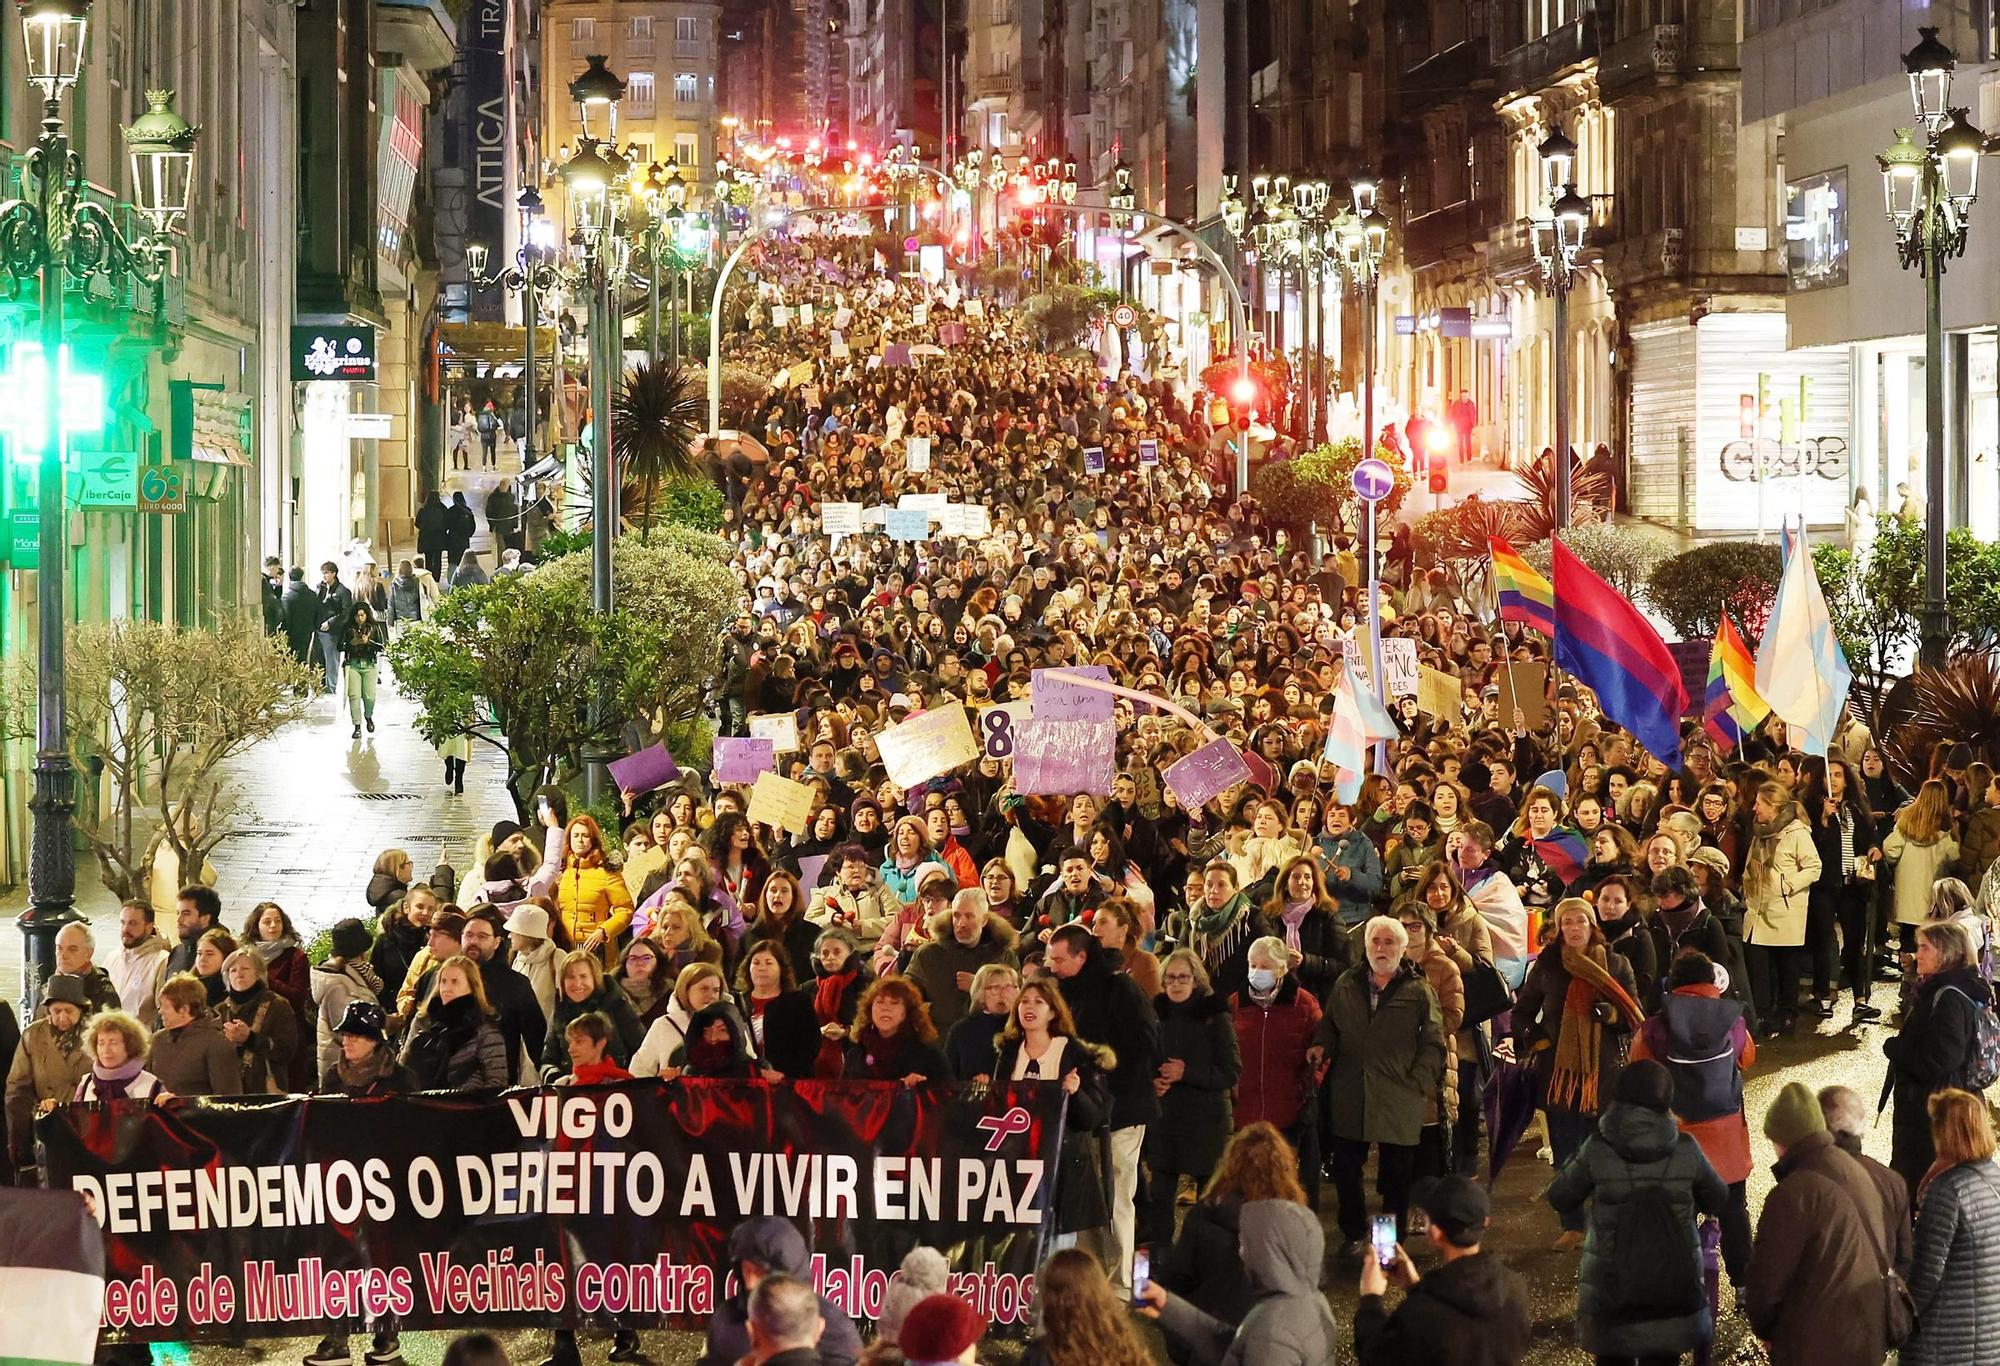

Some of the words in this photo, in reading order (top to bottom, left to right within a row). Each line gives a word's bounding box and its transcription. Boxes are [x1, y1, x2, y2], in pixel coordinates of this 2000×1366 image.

[1117, 311, 1131, 320] 40
[86, 489, 131, 501] iberCaja
[985, 710, 1014, 757] 8
[507, 1092, 633, 1139] VIGO
[72, 1157, 396, 1233] DEFENDEMOS
[407, 1155, 444, 1220] O
[456, 1151, 665, 1217] DEREITO
[680, 1153, 717, 1216] A
[728, 1152, 859, 1219] VIVIR
[873, 1156, 942, 1222] EN
[957, 1158, 1045, 1224] PAZ
[99, 1264, 179, 1328] ede
[187, 1262, 236, 1326] de
[244, 1256, 415, 1323] Mulleres
[419, 1246, 566, 1314] Veciñais
[576, 1253, 715, 1315] contra
[809, 1253, 901, 1320] alo
[944, 1258, 1037, 1326] ratos
